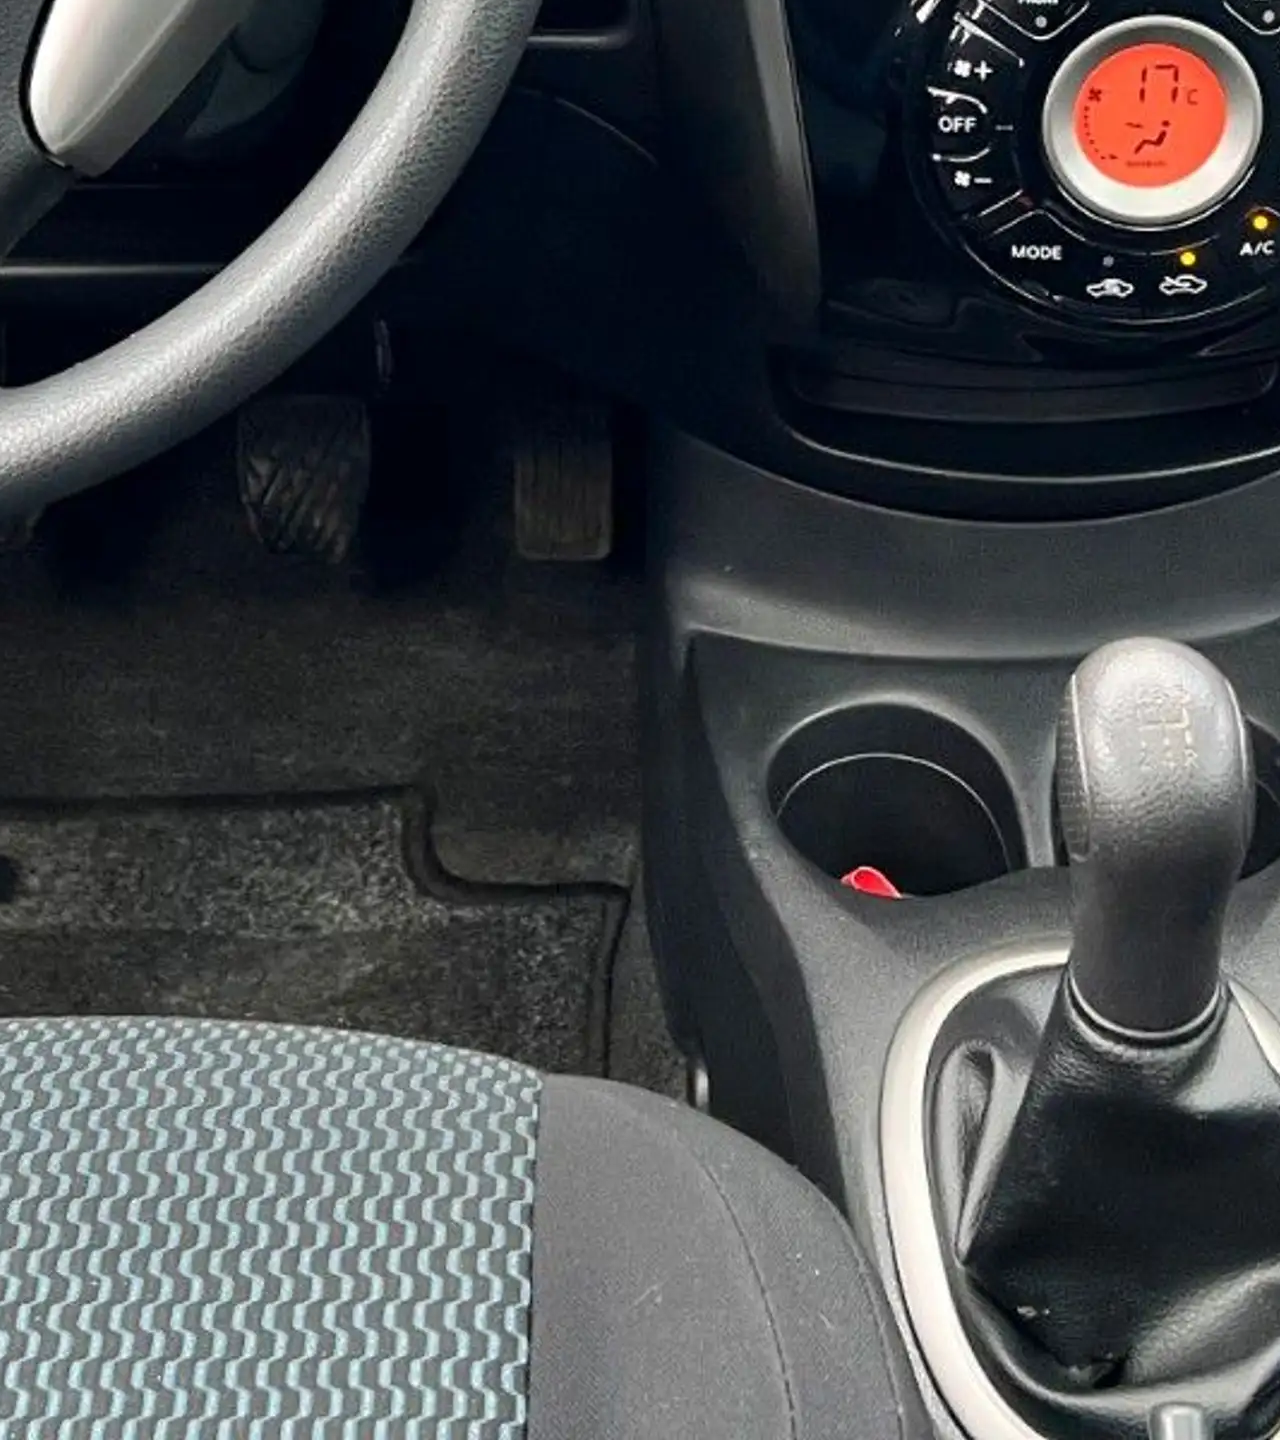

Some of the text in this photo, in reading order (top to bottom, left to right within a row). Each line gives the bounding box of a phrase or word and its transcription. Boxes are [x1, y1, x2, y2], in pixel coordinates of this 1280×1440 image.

[938, 115, 977, 133] OFF
[1011, 245, 1063, 260] MODE
[1239, 240, 1275, 256] A/C
